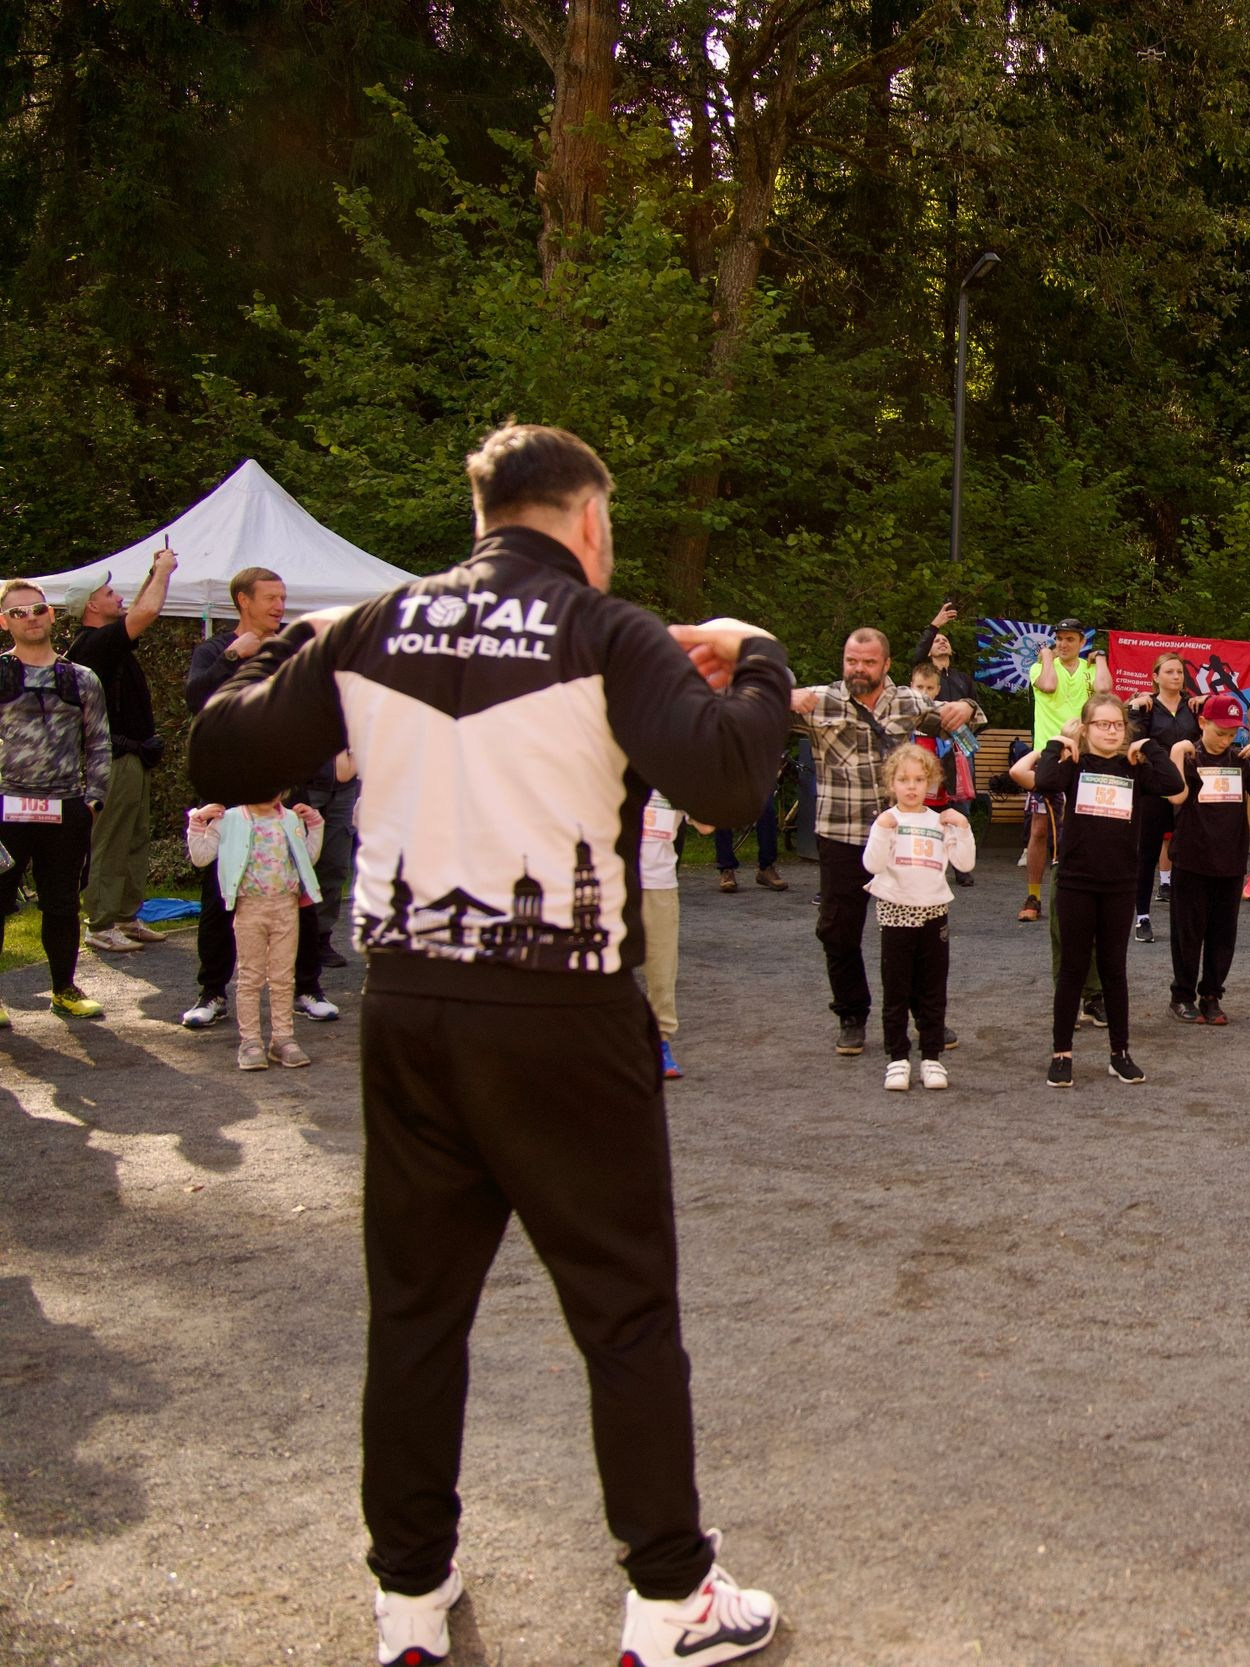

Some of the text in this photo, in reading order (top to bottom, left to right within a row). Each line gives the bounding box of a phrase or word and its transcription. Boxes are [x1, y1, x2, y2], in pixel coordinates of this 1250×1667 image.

[399, 591, 558, 636] TOTAL
[387, 633, 552, 661] VOLLEYBALL
[1118, 637, 1212, 650] БЕГИ КРАСНОЗНАМЕНСК
[1115, 677, 1153, 686] становятс
[19, 797, 49, 811] 103
[1095, 786, 1116, 805] 52
[913, 838, 933, 857] 53
